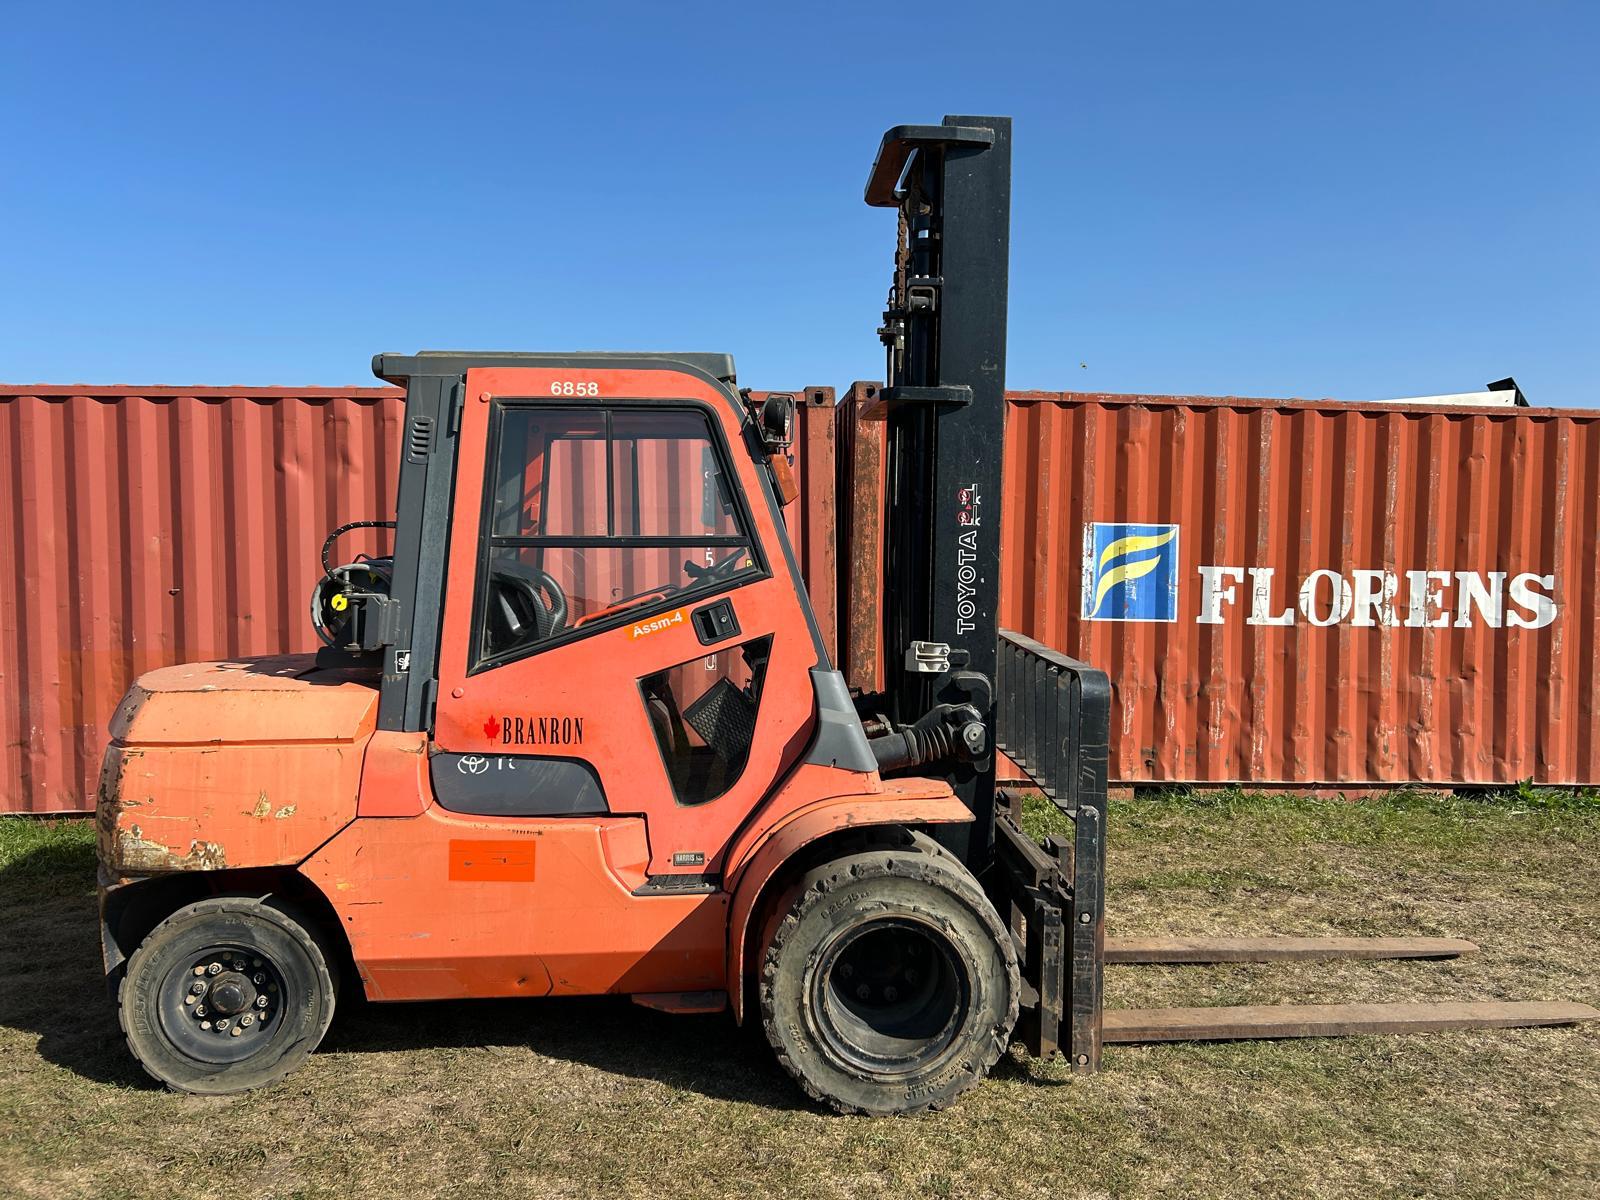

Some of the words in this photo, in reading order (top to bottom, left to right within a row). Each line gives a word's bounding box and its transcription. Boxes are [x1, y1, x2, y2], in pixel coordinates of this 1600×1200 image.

[550, 381, 599, 397] 6858
[956, 530, 978, 635] TOYOTA
[1195, 565, 1558, 630] FLORENS
[633, 611, 683, 638] Assm-4
[502, 716, 584, 745] BRANRON
